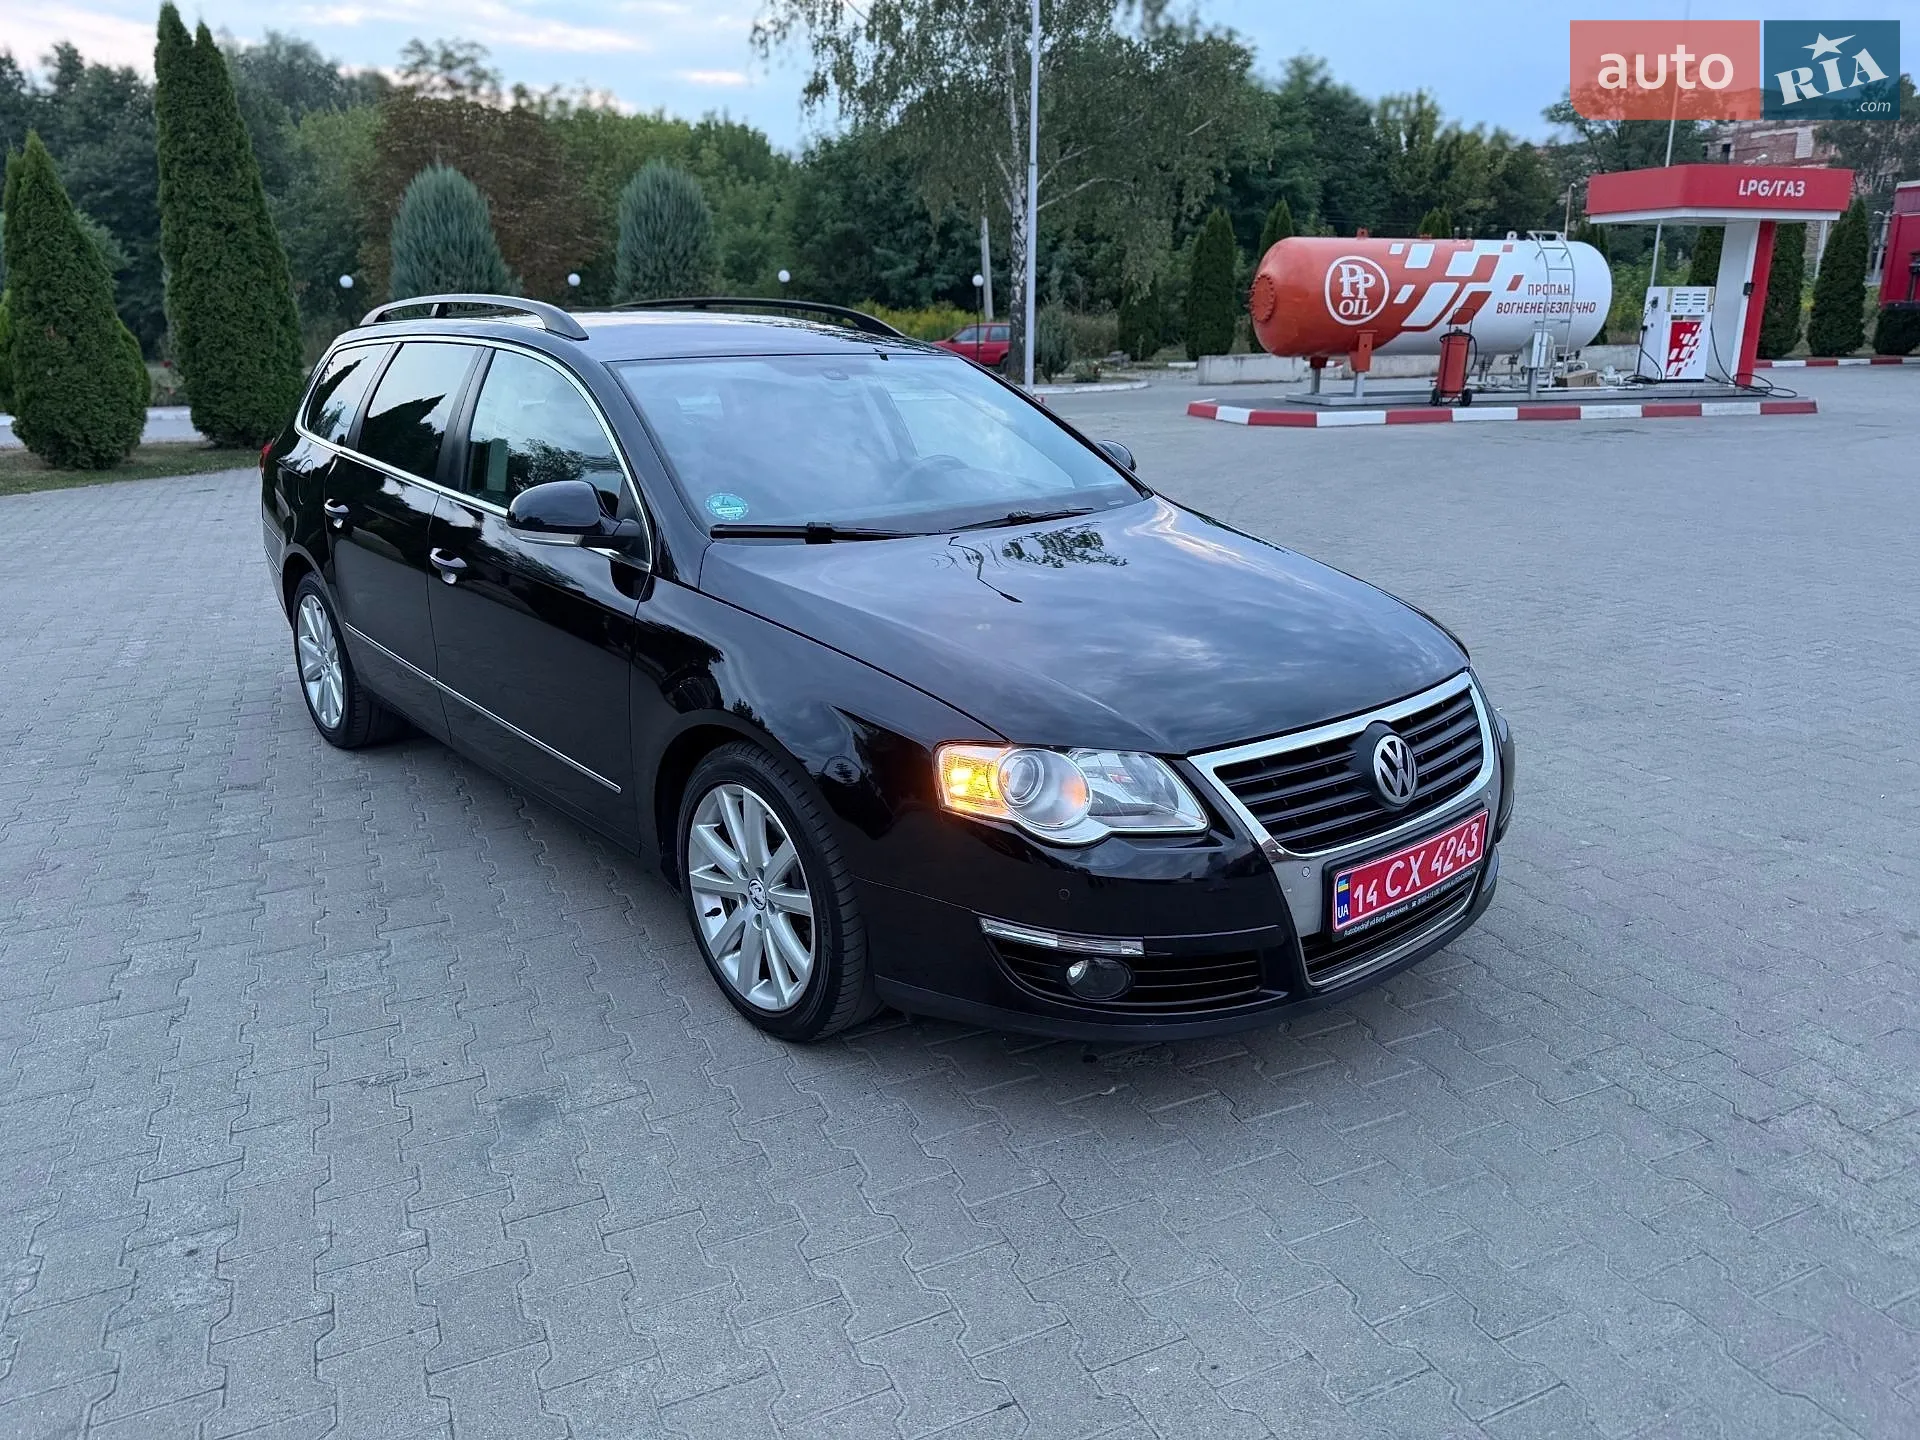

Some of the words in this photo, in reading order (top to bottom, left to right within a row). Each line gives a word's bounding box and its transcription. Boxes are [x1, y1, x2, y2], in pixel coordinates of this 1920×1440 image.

[1738, 179, 1806, 198] LPG/ГАЗ
[1338, 264, 1376, 299] PP
[1527, 283, 1571, 296] ПРОПАН
[1338, 299, 1371, 316] OIL
[1496, 301, 1597, 314] ВОГНЕНЕБЕЗПЕЧНО
[1337, 903, 1349, 919] UA
[1353, 878, 1378, 913] 14
[1385, 850, 1426, 898] CX
[1431, 822, 1480, 877] 4243
